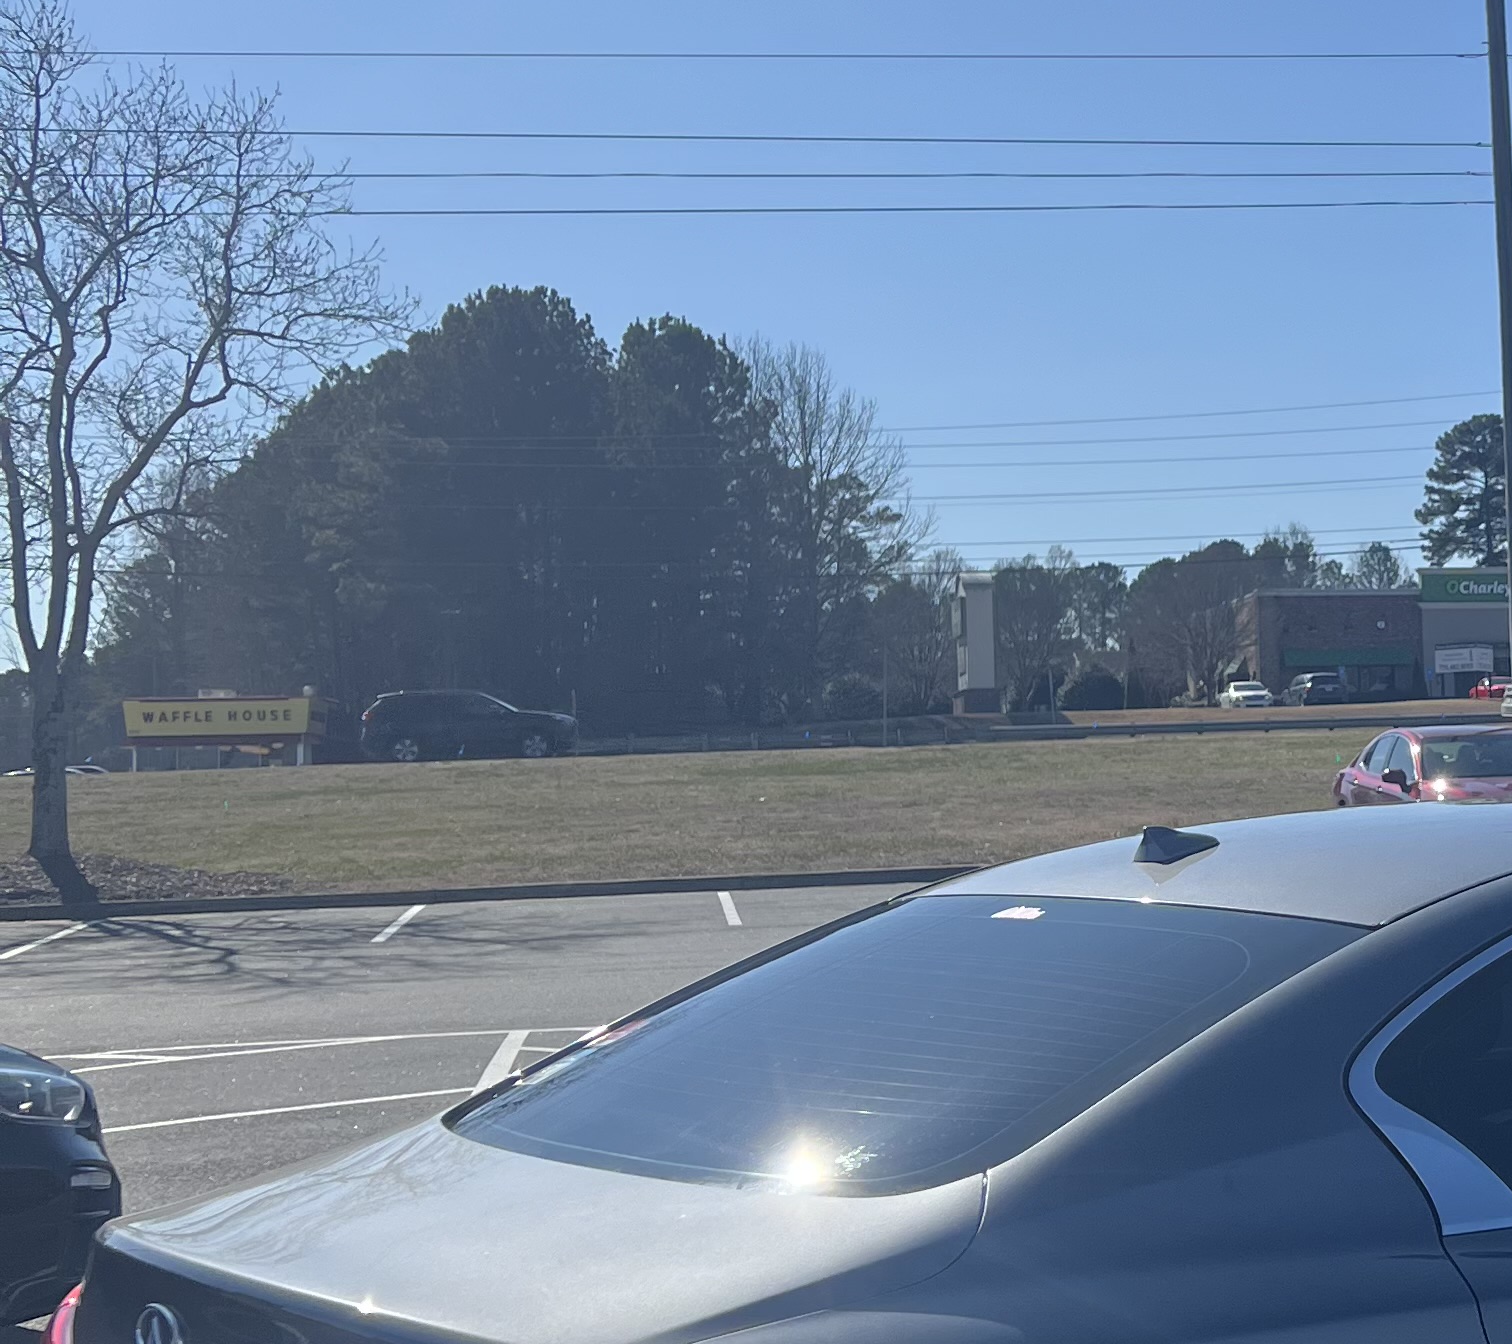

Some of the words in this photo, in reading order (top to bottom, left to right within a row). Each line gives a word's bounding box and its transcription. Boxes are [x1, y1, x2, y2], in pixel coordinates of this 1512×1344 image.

[1446, 579, 1511, 597] O'Charley
[142, 710, 213, 723] WAFFLE
[228, 709, 291, 722] HOUSE
